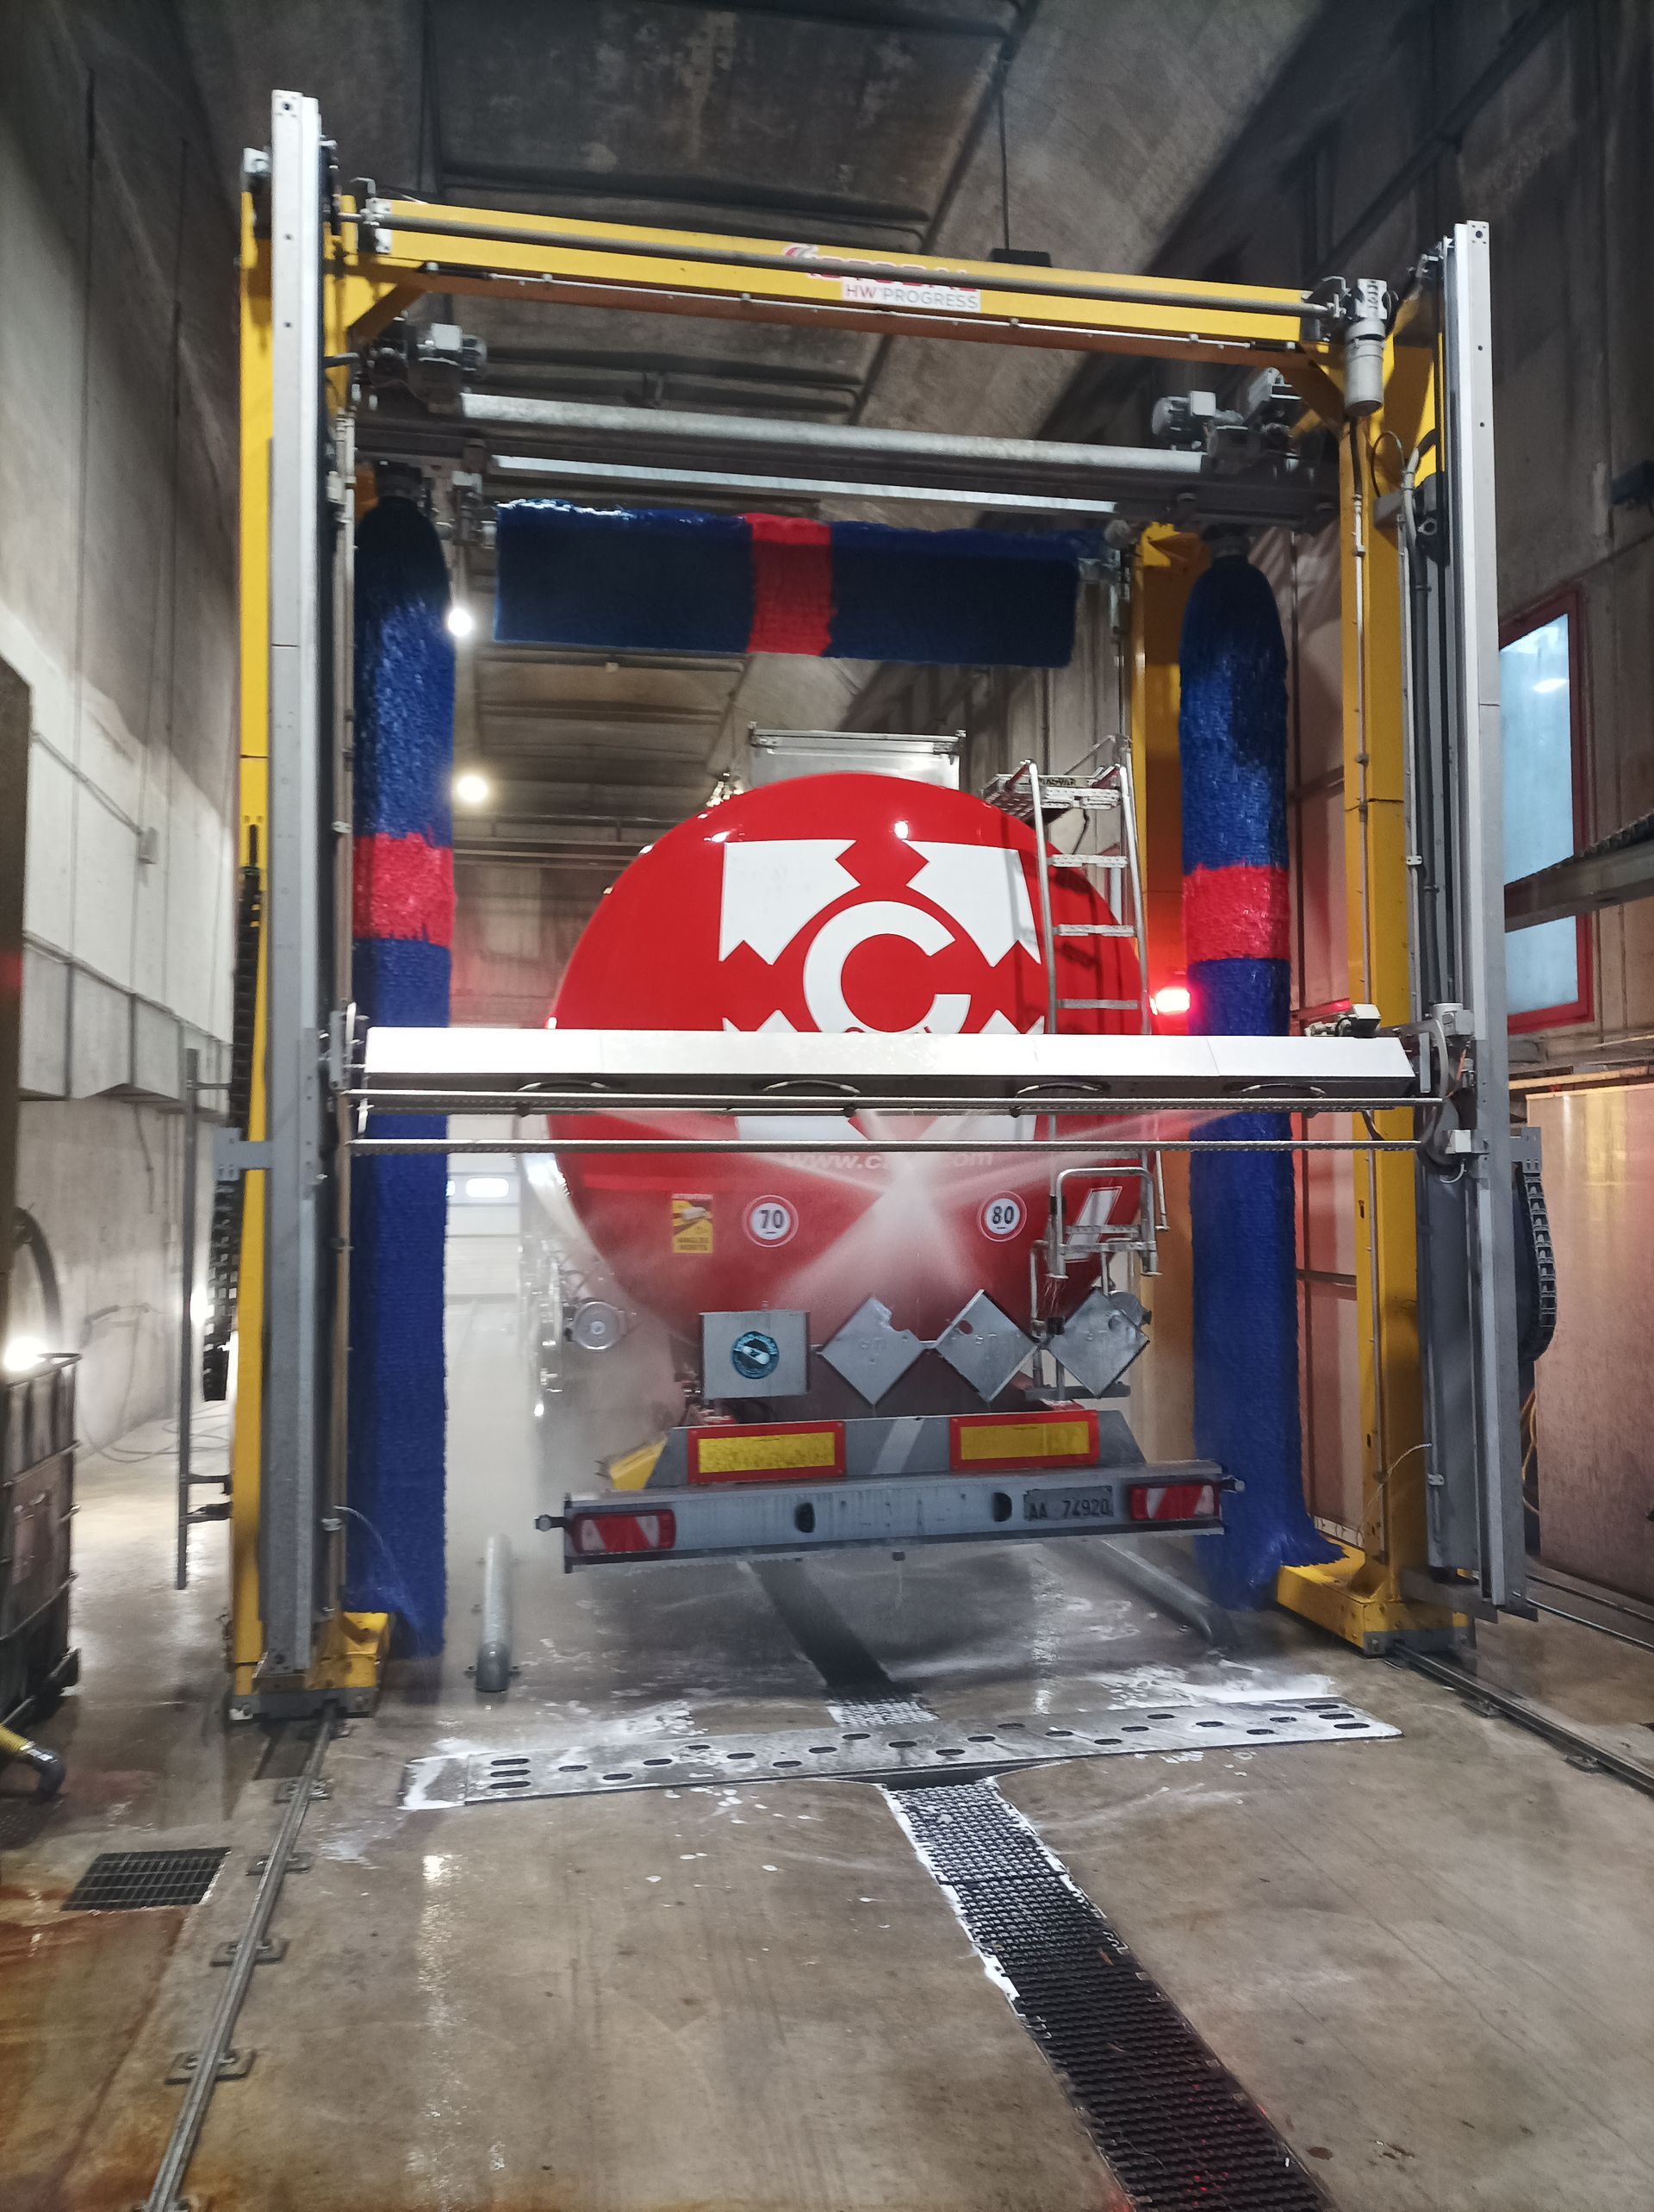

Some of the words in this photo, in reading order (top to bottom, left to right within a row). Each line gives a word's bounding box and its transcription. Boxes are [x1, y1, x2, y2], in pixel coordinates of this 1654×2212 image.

[847, 284, 876, 299] HW
[883, 287, 979, 309] PROGRESS
[759, 1209, 785, 1229] 70
[992, 1206, 1014, 1224] 80
